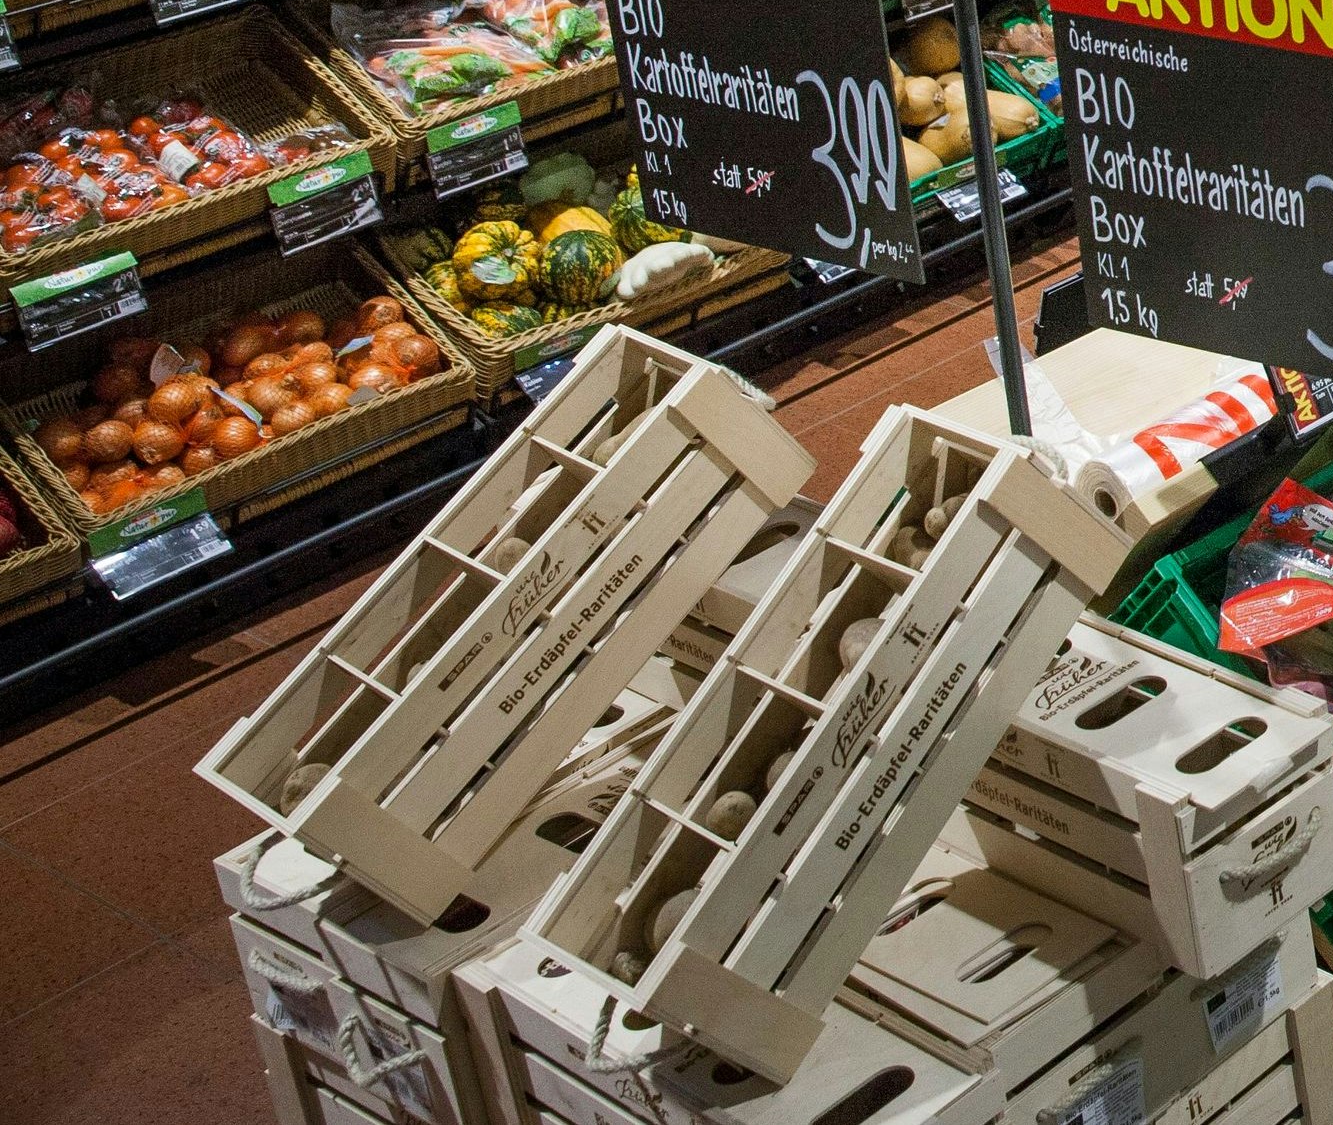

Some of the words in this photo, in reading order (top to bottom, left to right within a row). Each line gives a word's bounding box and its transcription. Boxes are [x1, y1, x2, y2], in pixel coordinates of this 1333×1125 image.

[1068, 20, 1189, 73] Österreichische
[625, 40, 800, 122] Kartoffelraritäten
[1074, 68, 1136, 131] BIO
[636, 98, 688, 149] Box
[711, 155, 741, 190] statt
[1082, 132, 1305, 228] Kartoffelraritäten
[671, 198, 688, 226] kg
[1090, 195, 1148, 249] Box
[871, 240, 887, 257] per
[1184, 271, 1214, 300] statt
[1137, 292, 1160, 338] kg
[497, 552, 644, 715] Bio-Erdäpfel-Raritäten
[1038, 659, 1141, 723] Bio-Erdäpfel-Raritäten
[834, 661, 968, 851] Bio-Erdäpfel-Raritäten
